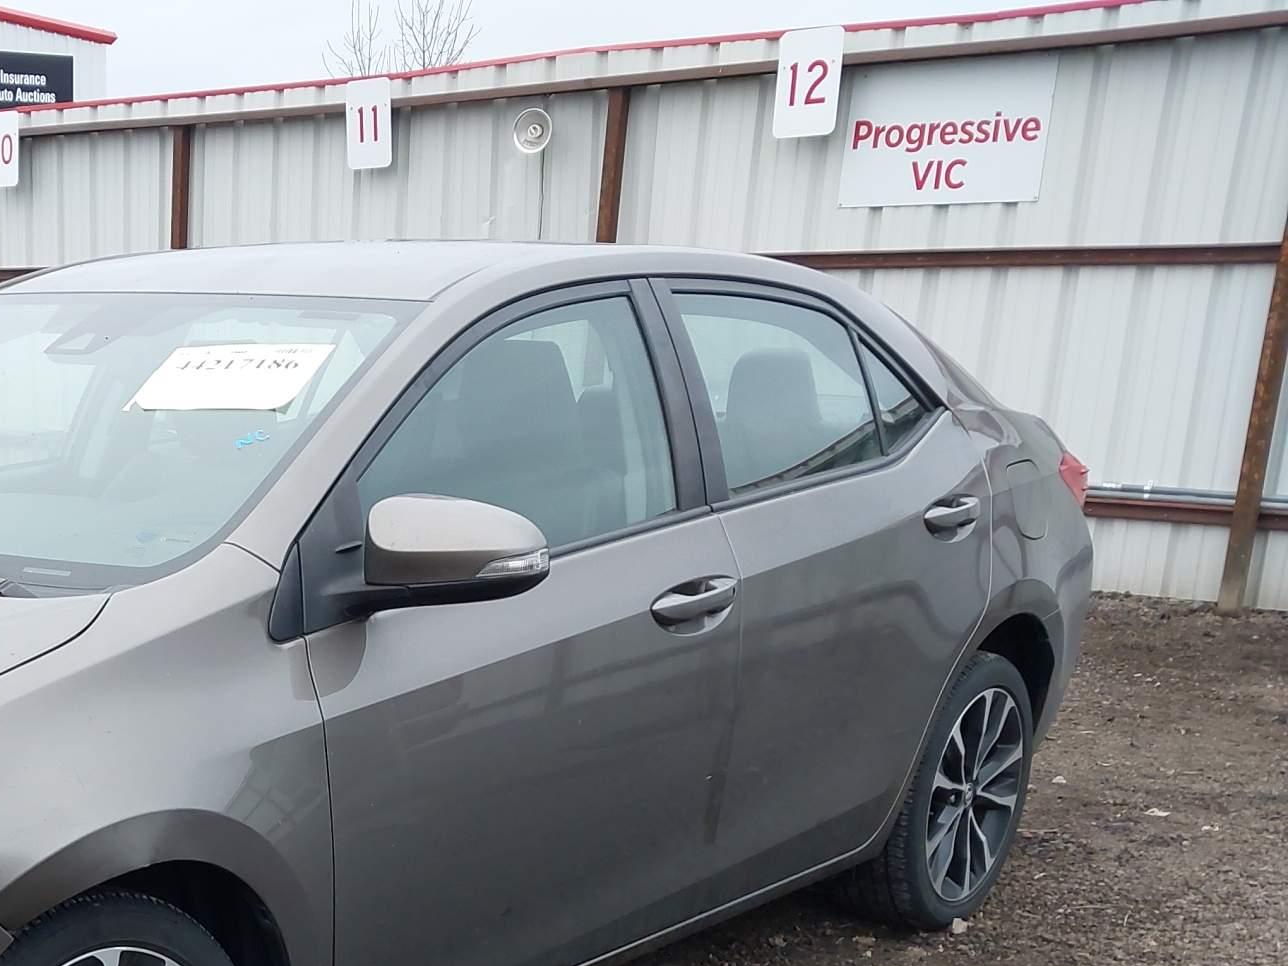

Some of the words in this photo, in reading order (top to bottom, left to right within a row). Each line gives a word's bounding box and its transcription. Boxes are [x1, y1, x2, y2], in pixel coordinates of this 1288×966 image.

[0, 69, 47, 86] Insurance
[788, 59, 829, 106] 12
[15, 87, 56, 104] Auctions
[357, 105, 379, 143] 11
[851, 111, 1042, 154] Progressive
[911, 159, 968, 191] VIC
